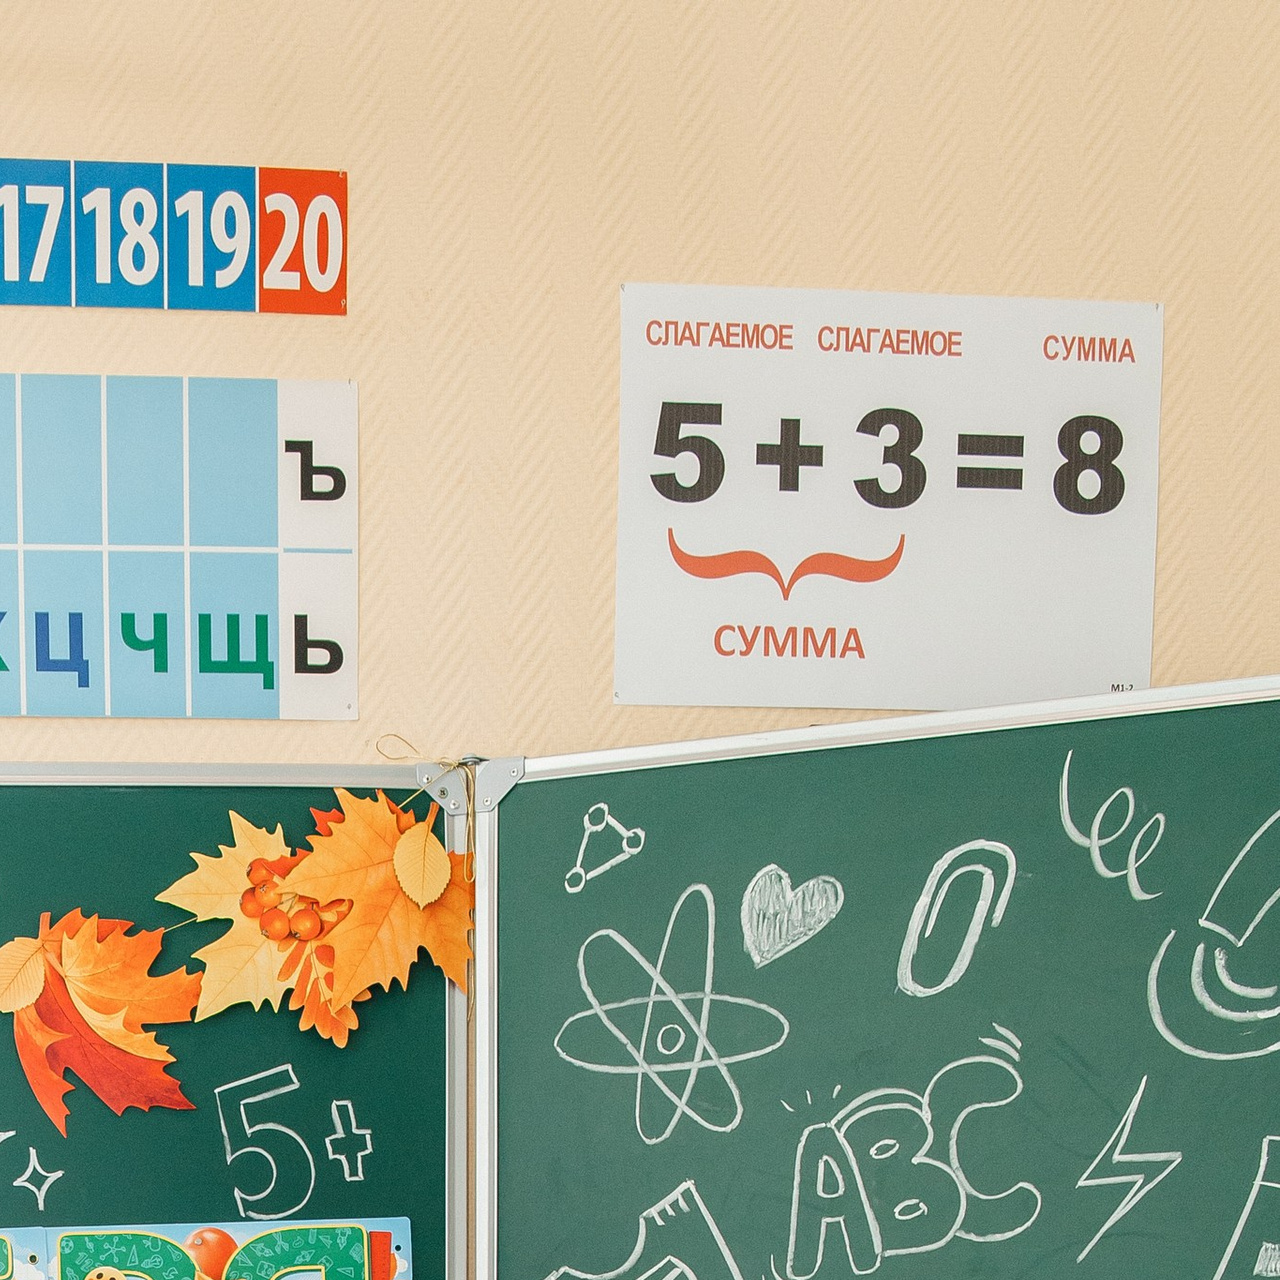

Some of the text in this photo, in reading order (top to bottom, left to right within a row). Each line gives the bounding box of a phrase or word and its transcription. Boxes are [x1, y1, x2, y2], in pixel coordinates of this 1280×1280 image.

[82, 188, 160, 285] 18
[175, 190, 251, 288] 19
[264, 193, 343, 290] 20
[646, 319, 1136, 363] СЛАГАЕМОЕ СЛАГАЕМОЕ СУММА
[284, 440, 347, 501] ъ
[35, 613, 90, 688] ц
[120, 613, 169, 674] ч
[197, 613, 275, 690] щ
[294, 615, 345, 674] ь
[714, 624, 866, 659] СУММА
[786, 1055, 1041, 1280] ABC
